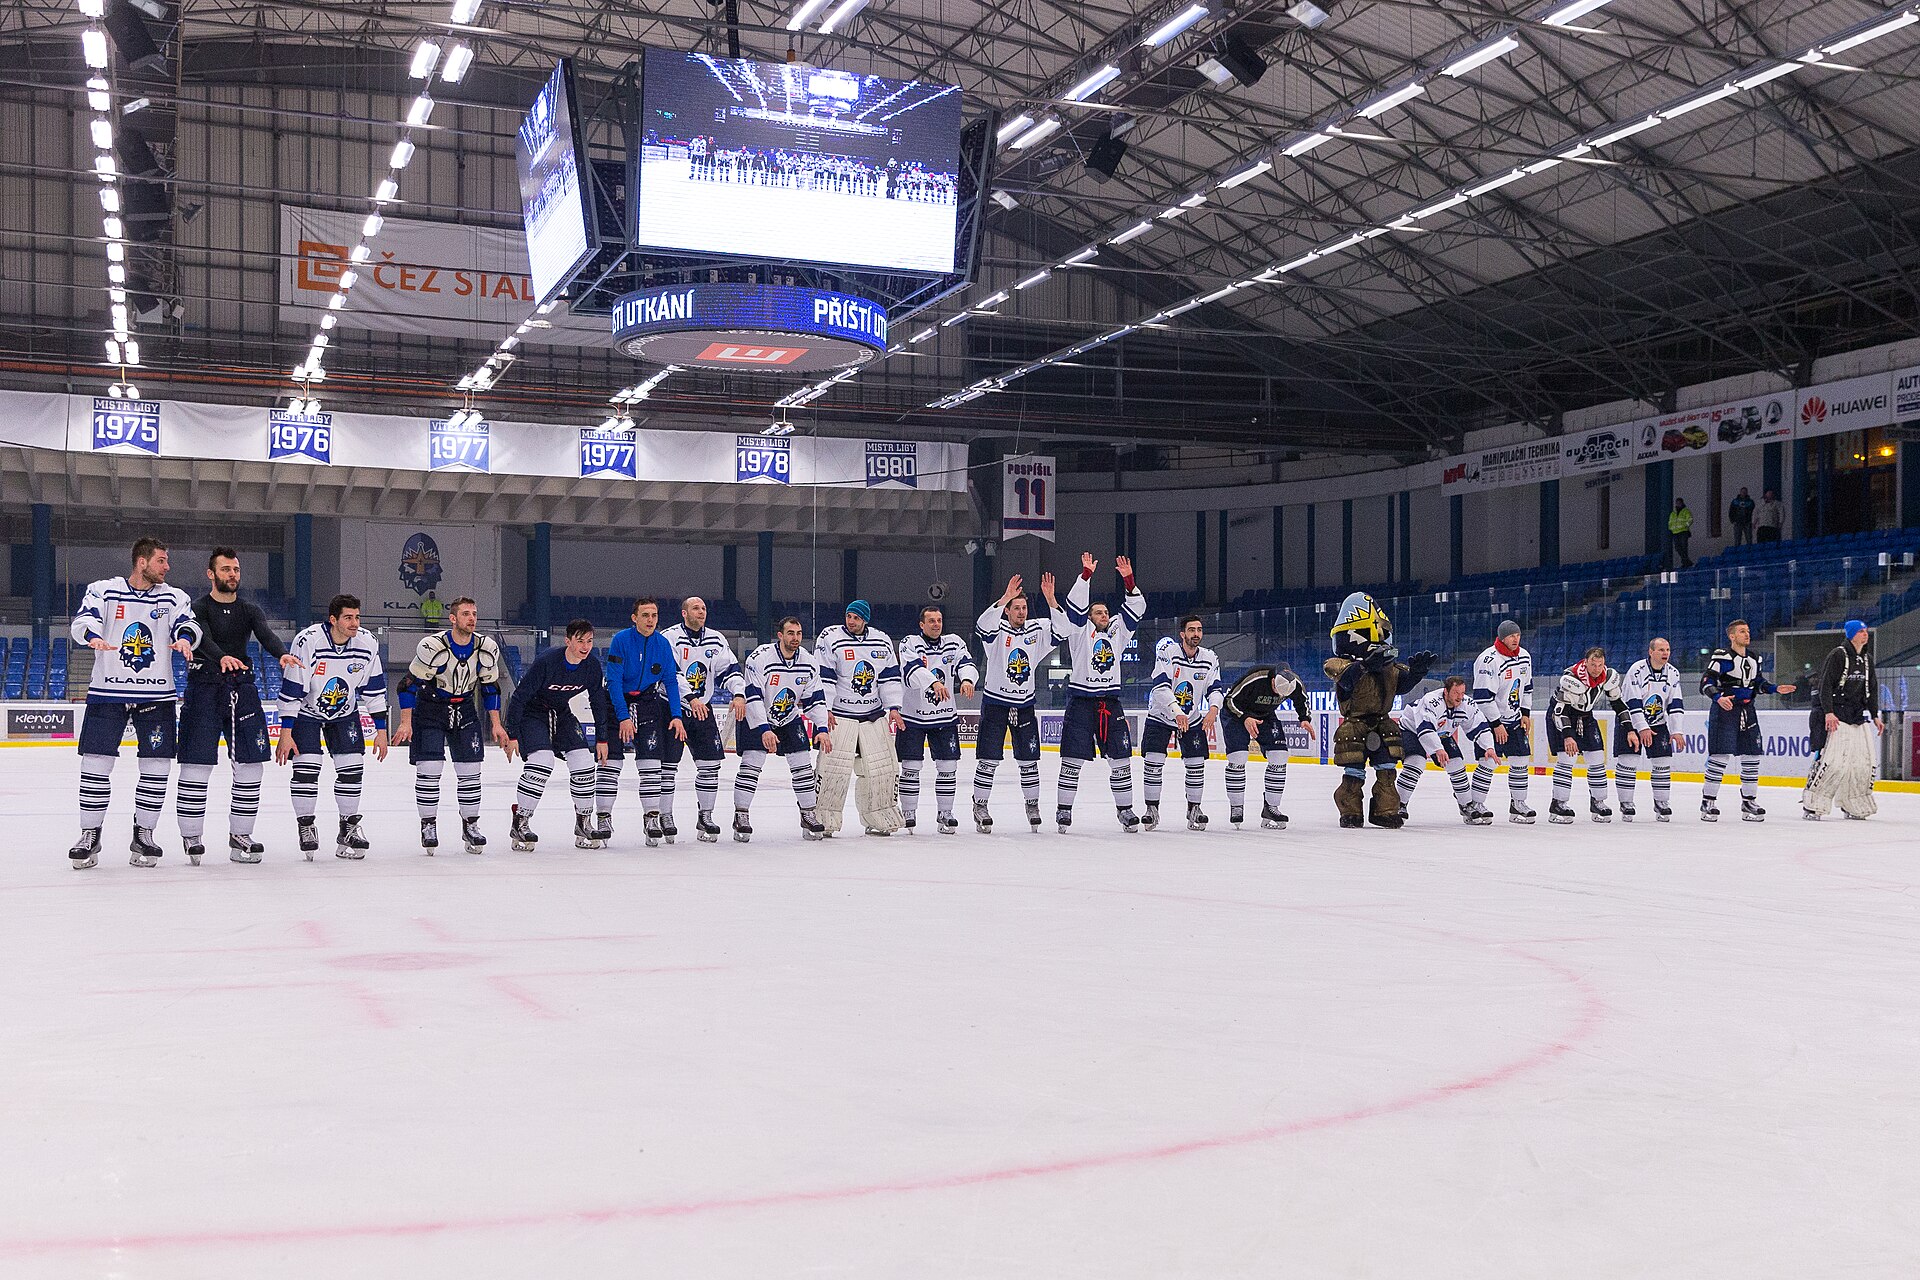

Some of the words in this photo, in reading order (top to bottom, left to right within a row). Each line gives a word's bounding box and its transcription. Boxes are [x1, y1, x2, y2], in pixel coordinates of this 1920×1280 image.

[373, 251, 441, 293] ČEZ
[626, 289, 695, 327] UTKÁNÍ
[814, 297, 872, 334] PŘÍŠTÍ
[95, 400, 130, 410] MISTR
[134, 401, 159, 413] LIGY
[1831, 395, 1888, 416] HUAWEI
[95, 414, 157, 442] 1975
[271, 425, 330, 453] 1976
[431, 436, 487, 461] 1977
[738, 437, 766, 447] MISTR
[769, 438, 790, 448] LIGY
[866, 443, 894, 452] MISTR
[896, 444, 916, 452] LIGY
[1527, 441, 1560, 459] TECHNIKA
[582, 444, 635, 468] 1977
[738, 450, 789, 474] 1978
[867, 456, 916, 477] 1980
[1007, 463, 1052, 476] POSPÍŠIL
[1014, 478, 1046, 516] 11
[1483, 656, 1495, 664] 87
[104, 677, 167, 685] KLADNO
